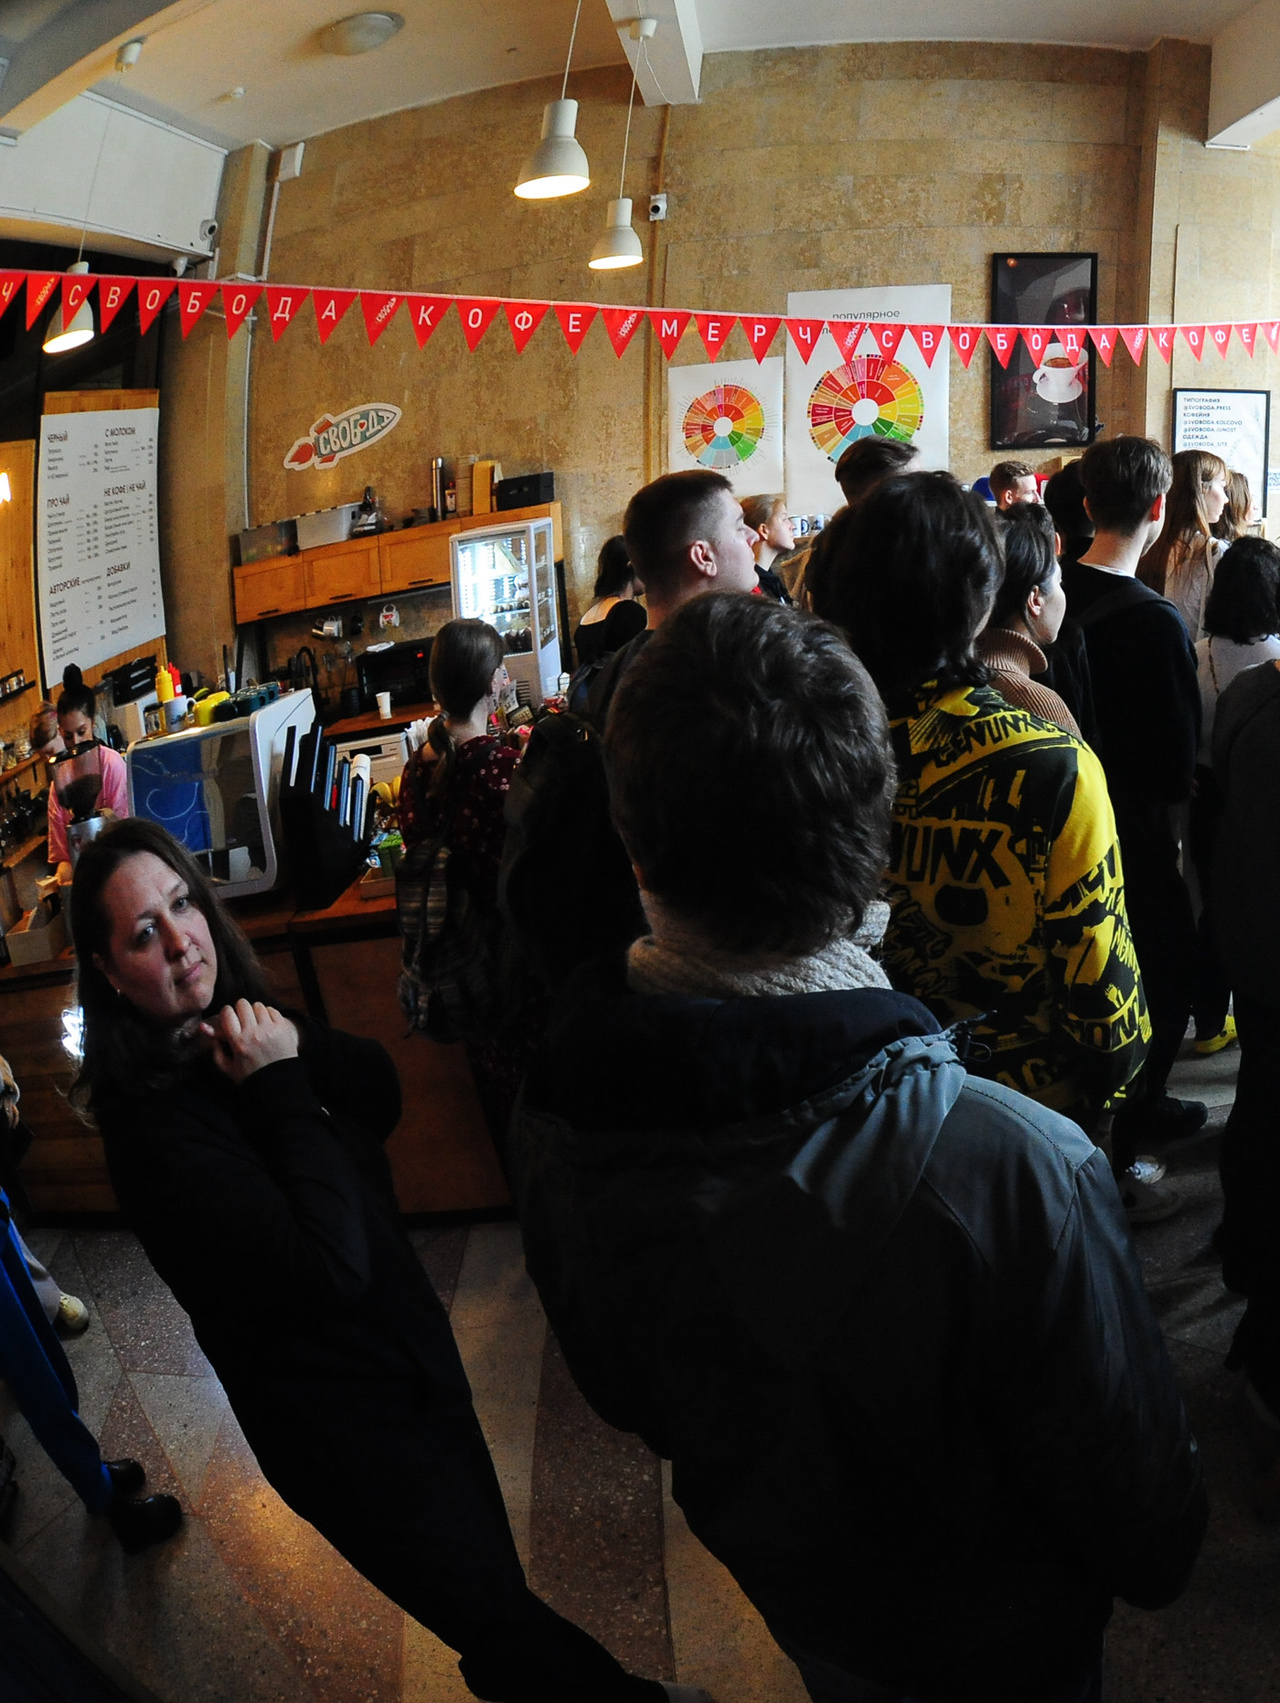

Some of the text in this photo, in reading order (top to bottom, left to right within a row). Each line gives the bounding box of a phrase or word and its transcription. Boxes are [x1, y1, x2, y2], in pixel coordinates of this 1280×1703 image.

[68, 284, 337, 321] СВОБОДА
[418, 305, 582, 333] КОФЕ
[661, 319, 812, 344] МЕРЧ
[882, 330, 1111, 353] СВОБОДА
[1158, 328, 1251, 348] КОФЕ
[832, 311, 900, 320] популярное
